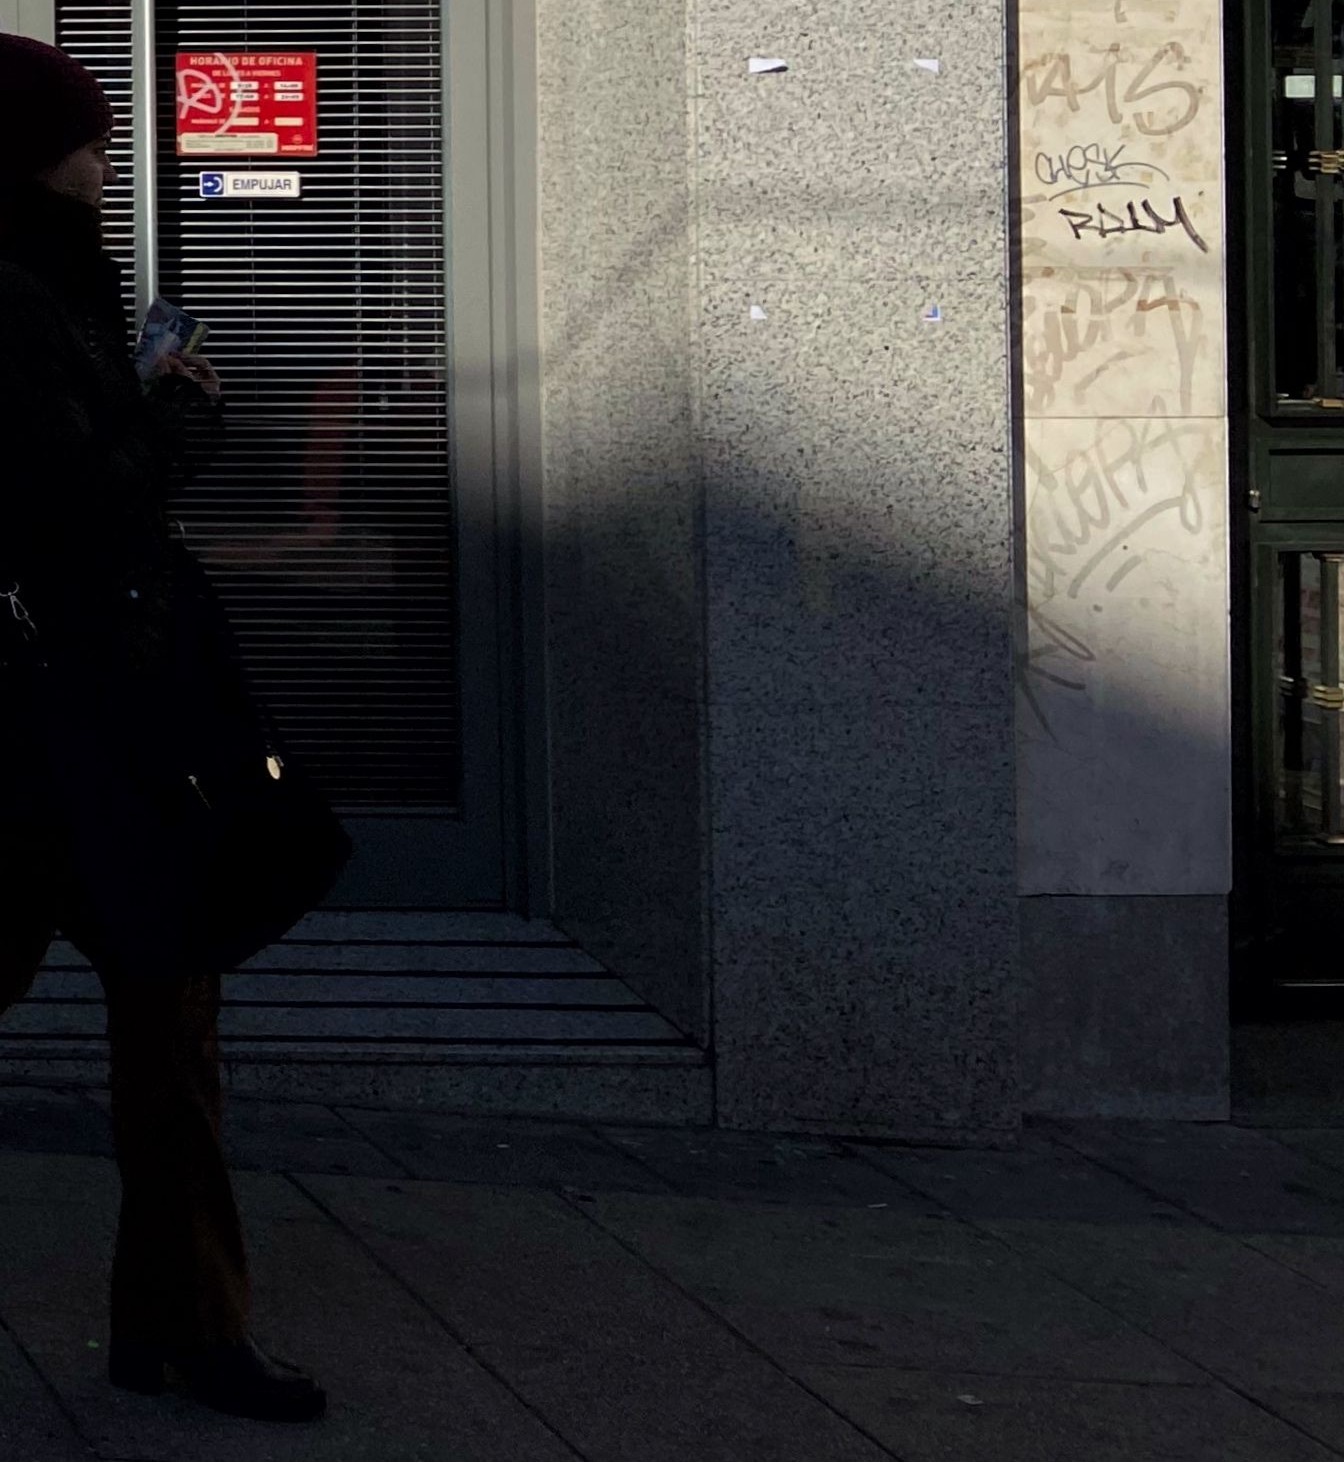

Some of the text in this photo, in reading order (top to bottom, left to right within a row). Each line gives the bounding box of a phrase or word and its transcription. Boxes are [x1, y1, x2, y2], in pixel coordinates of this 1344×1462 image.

[241, 56, 256, 66] DE
[259, 56, 303, 66] OFICINA
[232, 179, 292, 190] EMPUJAR
